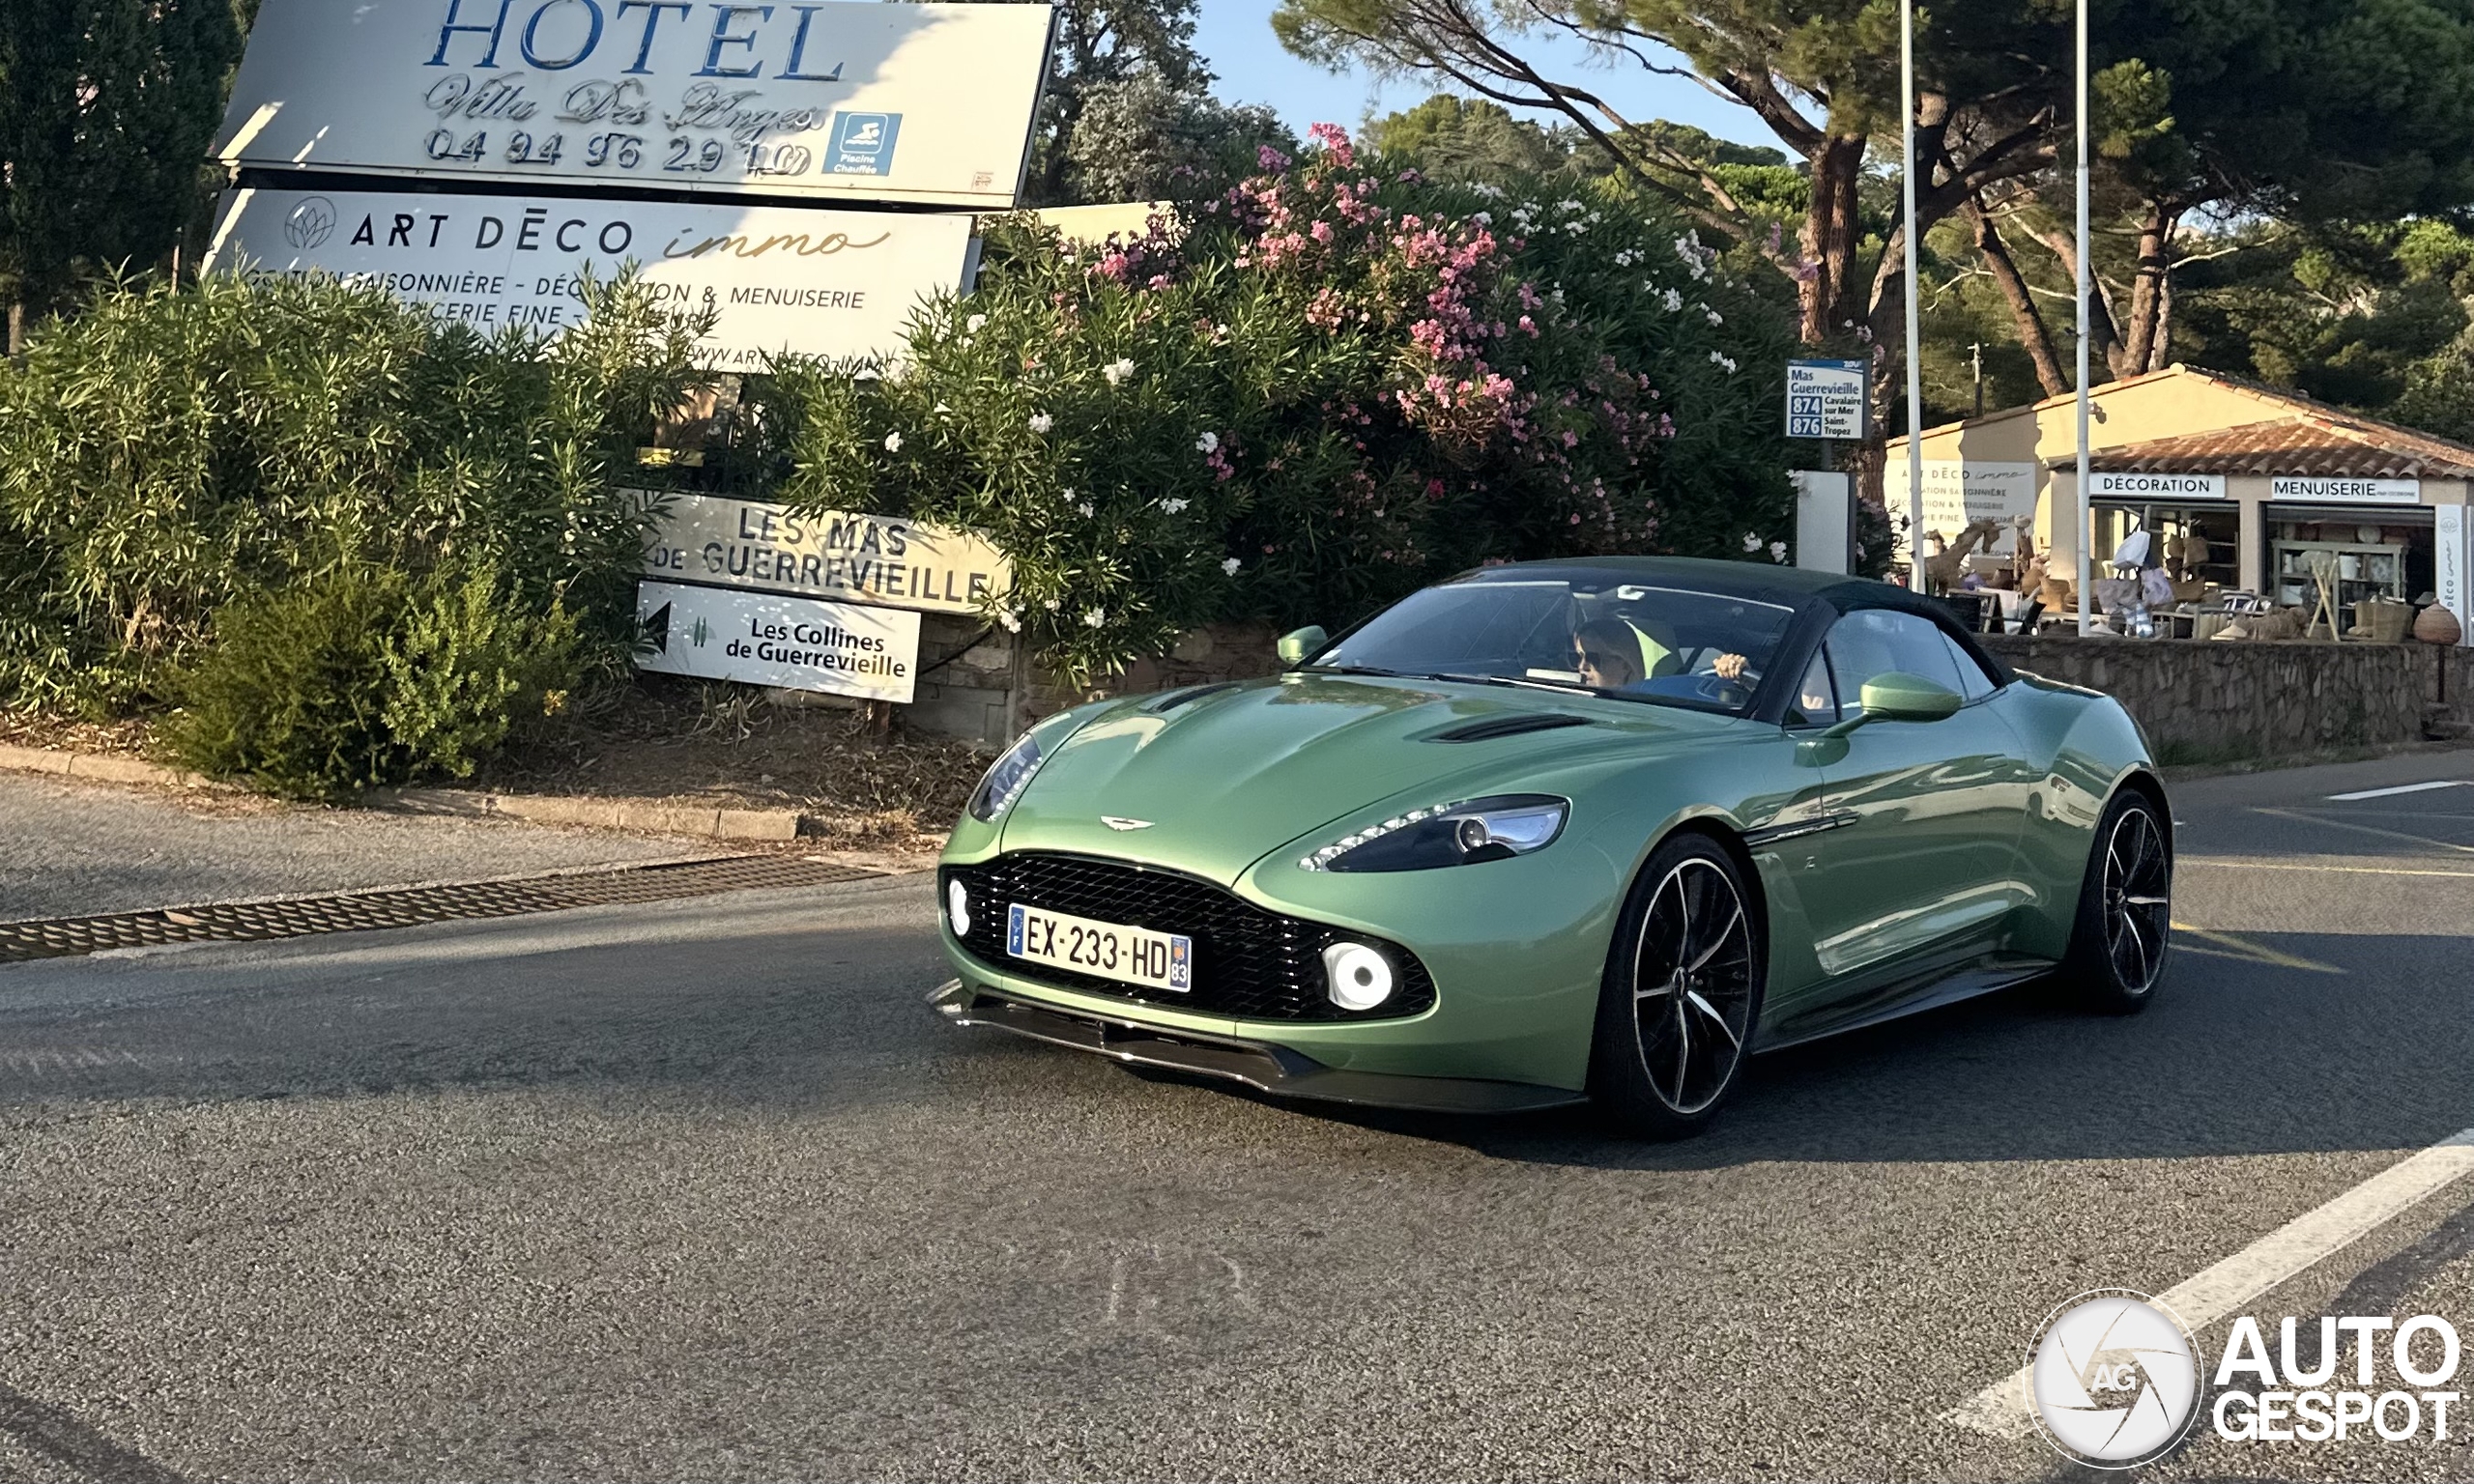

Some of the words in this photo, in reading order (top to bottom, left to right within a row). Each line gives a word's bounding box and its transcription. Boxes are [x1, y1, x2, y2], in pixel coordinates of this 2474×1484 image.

[422, 0, 845, 81] HOTEL
[424, 72, 540, 121] Villa
[424, 128, 487, 162] 04
[586, 131, 643, 169] 96
[663, 135, 724, 173] 29
[839, 154, 877, 164] Piscine
[833, 163, 877, 175] Chauffée
[350, 212, 449, 248] ART
[663, 227, 891, 259] immo
[351, 271, 505, 296] SAISONNIÈRE
[703, 286, 717, 303] &
[730, 286, 866, 310] MENUISERIE
[507, 304, 563, 325] FINE
[1791, 369, 1814, 382] Mas
[1791, 382, 1859, 394] Guerrevieille
[1793, 397, 1821, 414] 874
[1825, 396, 1861, 405] Cavalaire
[1838, 406, 1855, 414] Mer
[1793, 417, 1821, 435] 876
[1825, 416, 1848, 425] Saint-
[1825, 426, 1851, 437] Tropez
[2102, 472, 2211, 494] DÉCORATION
[2274, 480, 2376, 497] MENUISERIE
[738, 506, 804, 545] LES
[829, 517, 907, 557] MAS
[653, 546, 684, 570] DE
[703, 541, 990, 605] GUERREVIEILLE
[751, 617, 788, 641] Les
[794, 623, 884, 652] Collines
[726, 638, 752, 659] de
[757, 642, 906, 677] Guerrevieille
[1013, 935, 1020, 947] F
[1026, 915, 1167, 980] EX-233-HD
[1170, 963, 1188, 983] 83
